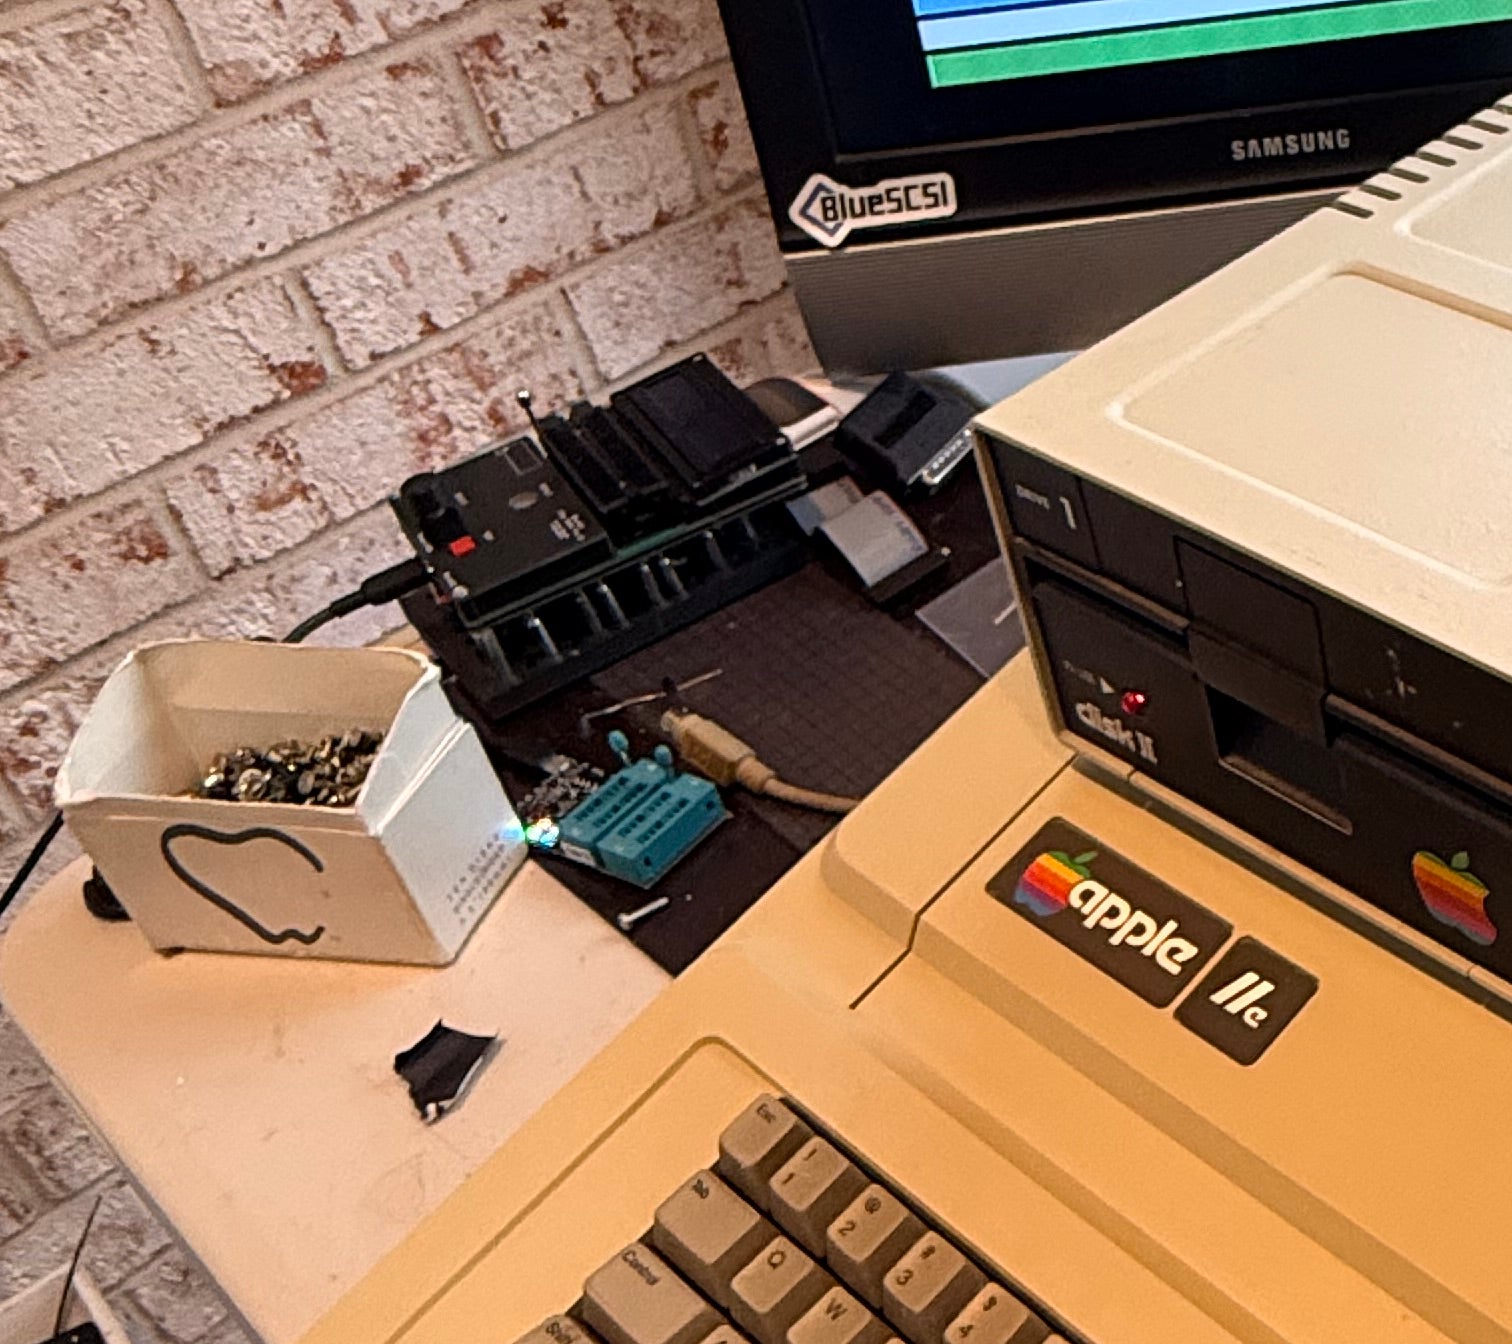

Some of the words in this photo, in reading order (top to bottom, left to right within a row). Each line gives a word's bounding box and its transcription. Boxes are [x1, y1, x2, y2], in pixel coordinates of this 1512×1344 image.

[1231, 128, 1350, 161] SAMSUNG
[820, 180, 948, 222] BlueSCSI
[1059, 496, 1077, 530] 1
[1076, 702, 1136, 753] disk
[1069, 880, 1199, 976] apple
[864, 1196, 881, 1214] @
[838, 1220, 855, 1236] 2
[767, 1249, 787, 1271] Q
[896, 1270, 914, 1286] 3
[824, 1298, 848, 1321] W
[959, 1324, 974, 1338] 4
